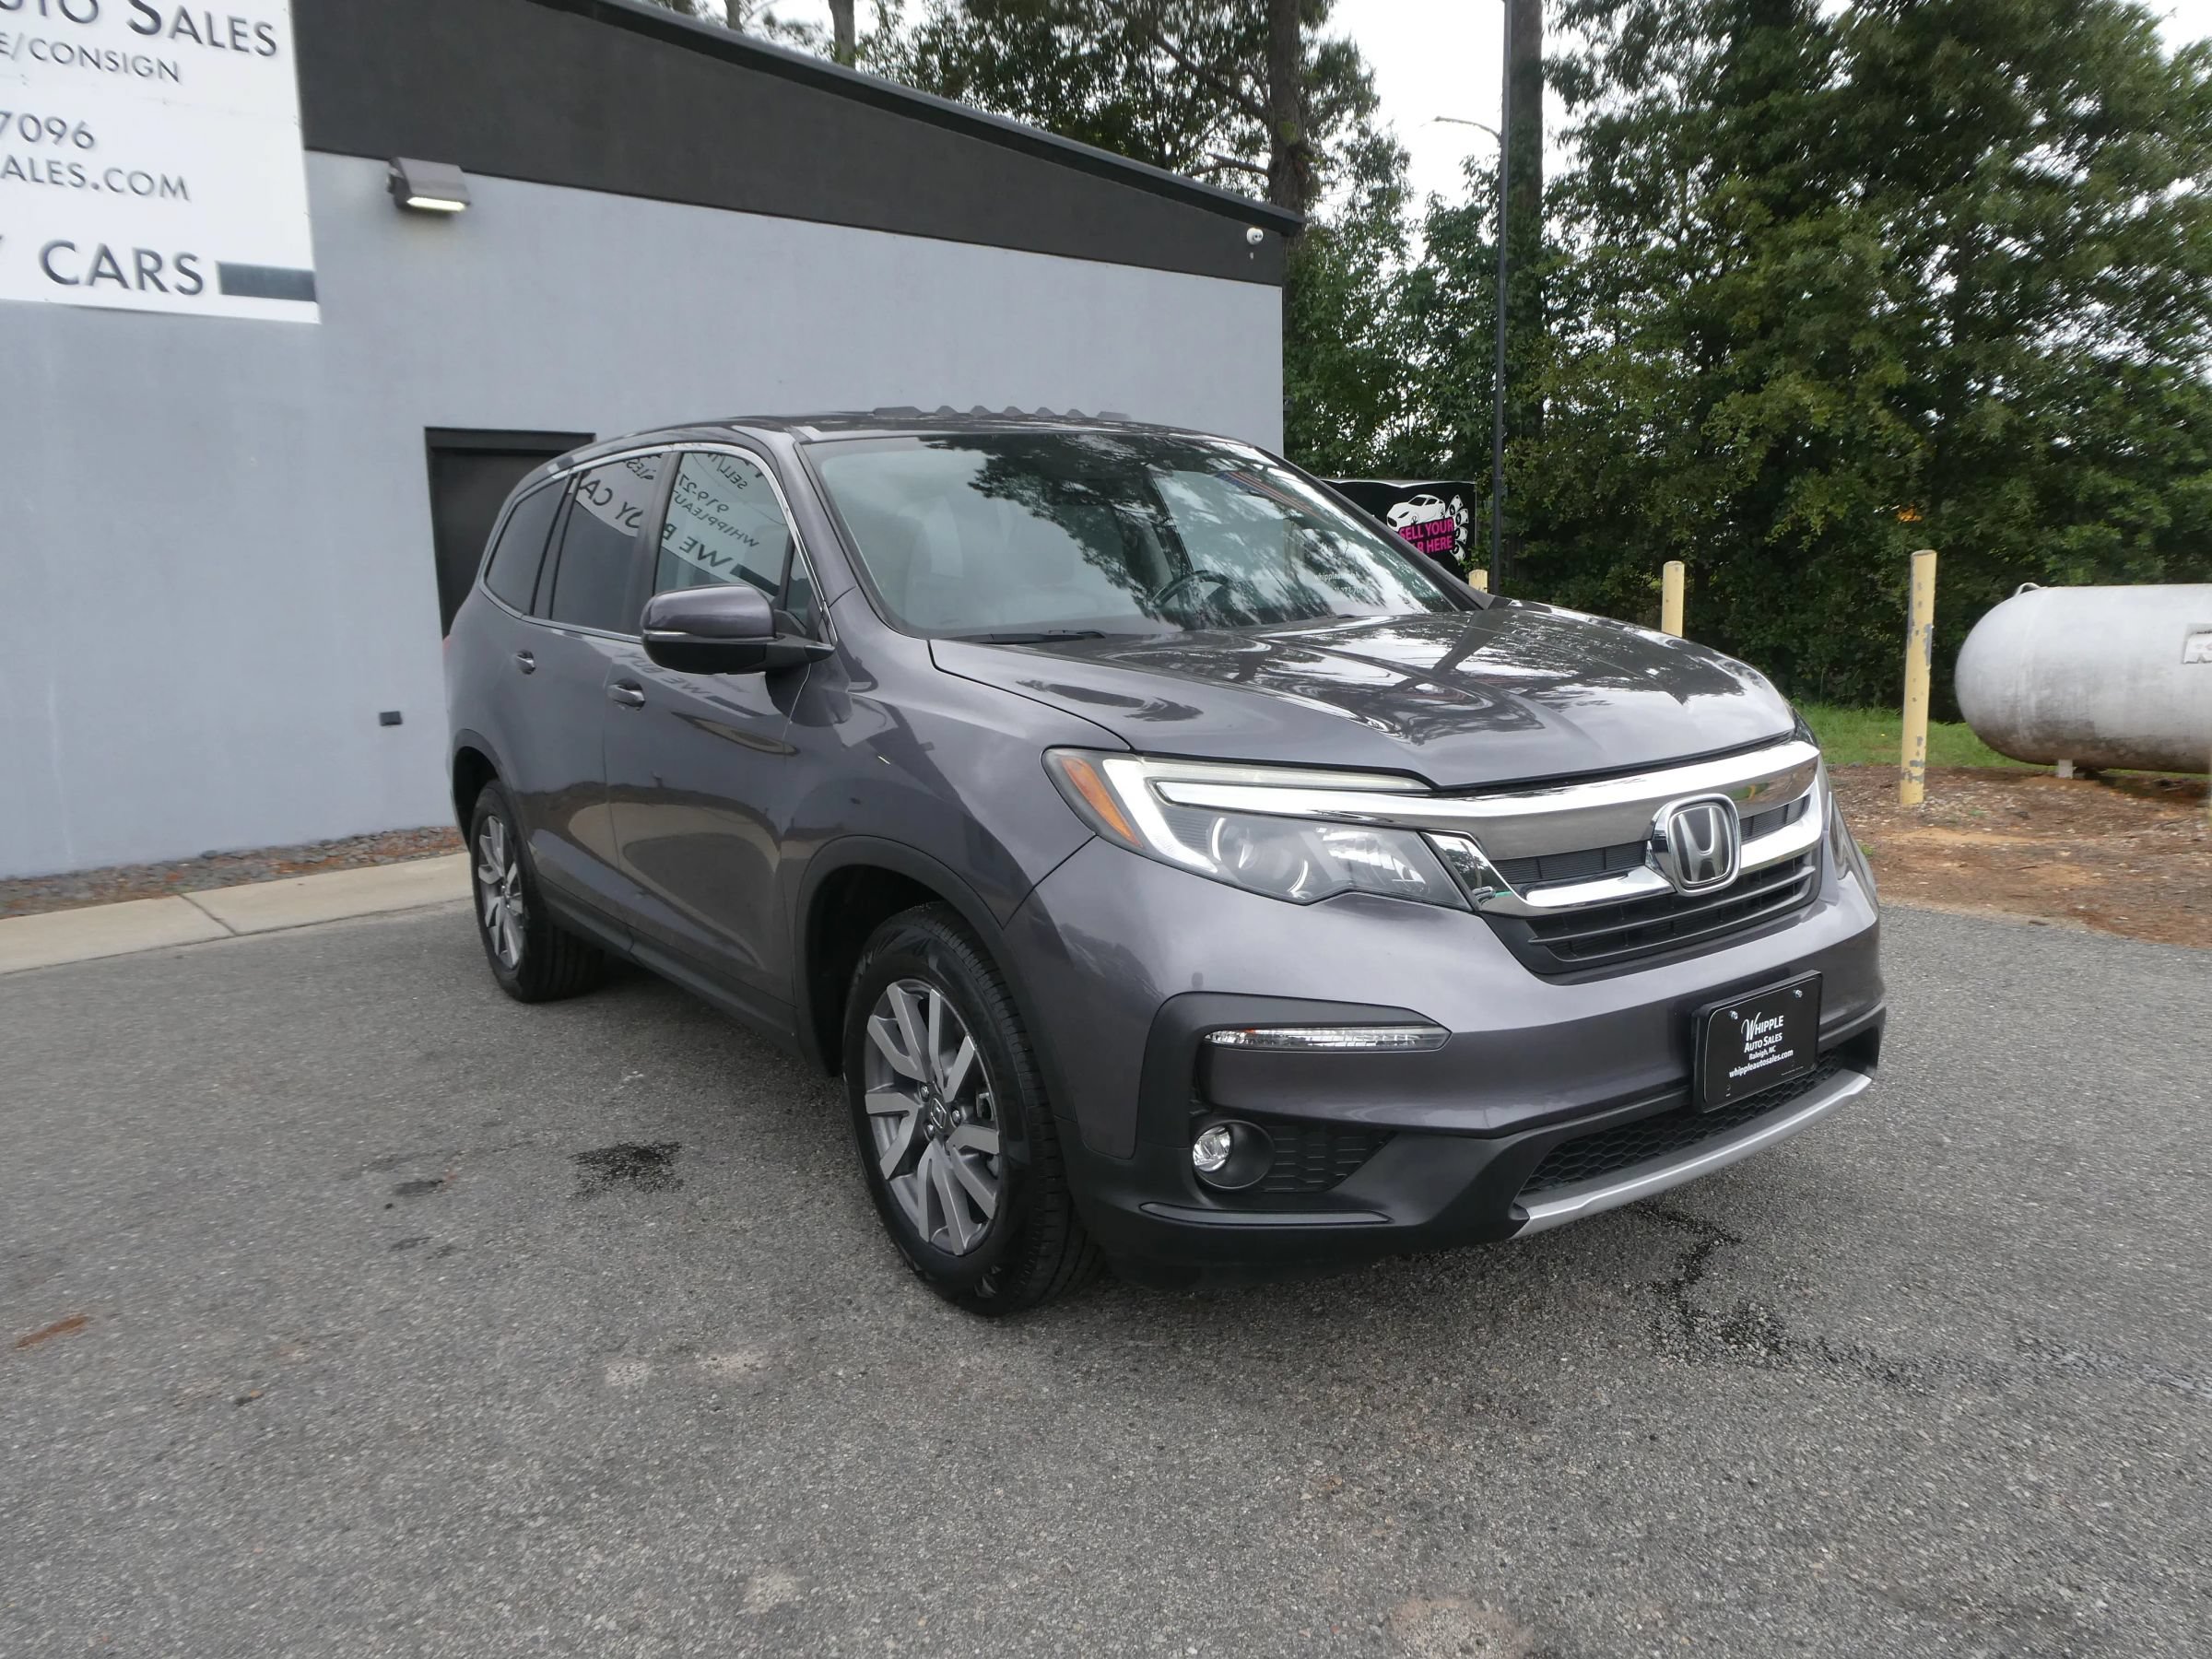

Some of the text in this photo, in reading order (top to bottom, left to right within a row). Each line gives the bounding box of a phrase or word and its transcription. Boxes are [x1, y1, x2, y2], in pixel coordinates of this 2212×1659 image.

[126, 0, 277, 57] SALES
[0, 154, 191, 202] ALES.COM
[38, 239, 205, 296] CARS
[1399, 518, 1454, 541] SELL YOUR
[1427, 535, 1453, 553] HERE
[1744, 1032, 1783, 1053] AUTO SALES
[1728, 1049, 1794, 1077] whippleautosales.com
